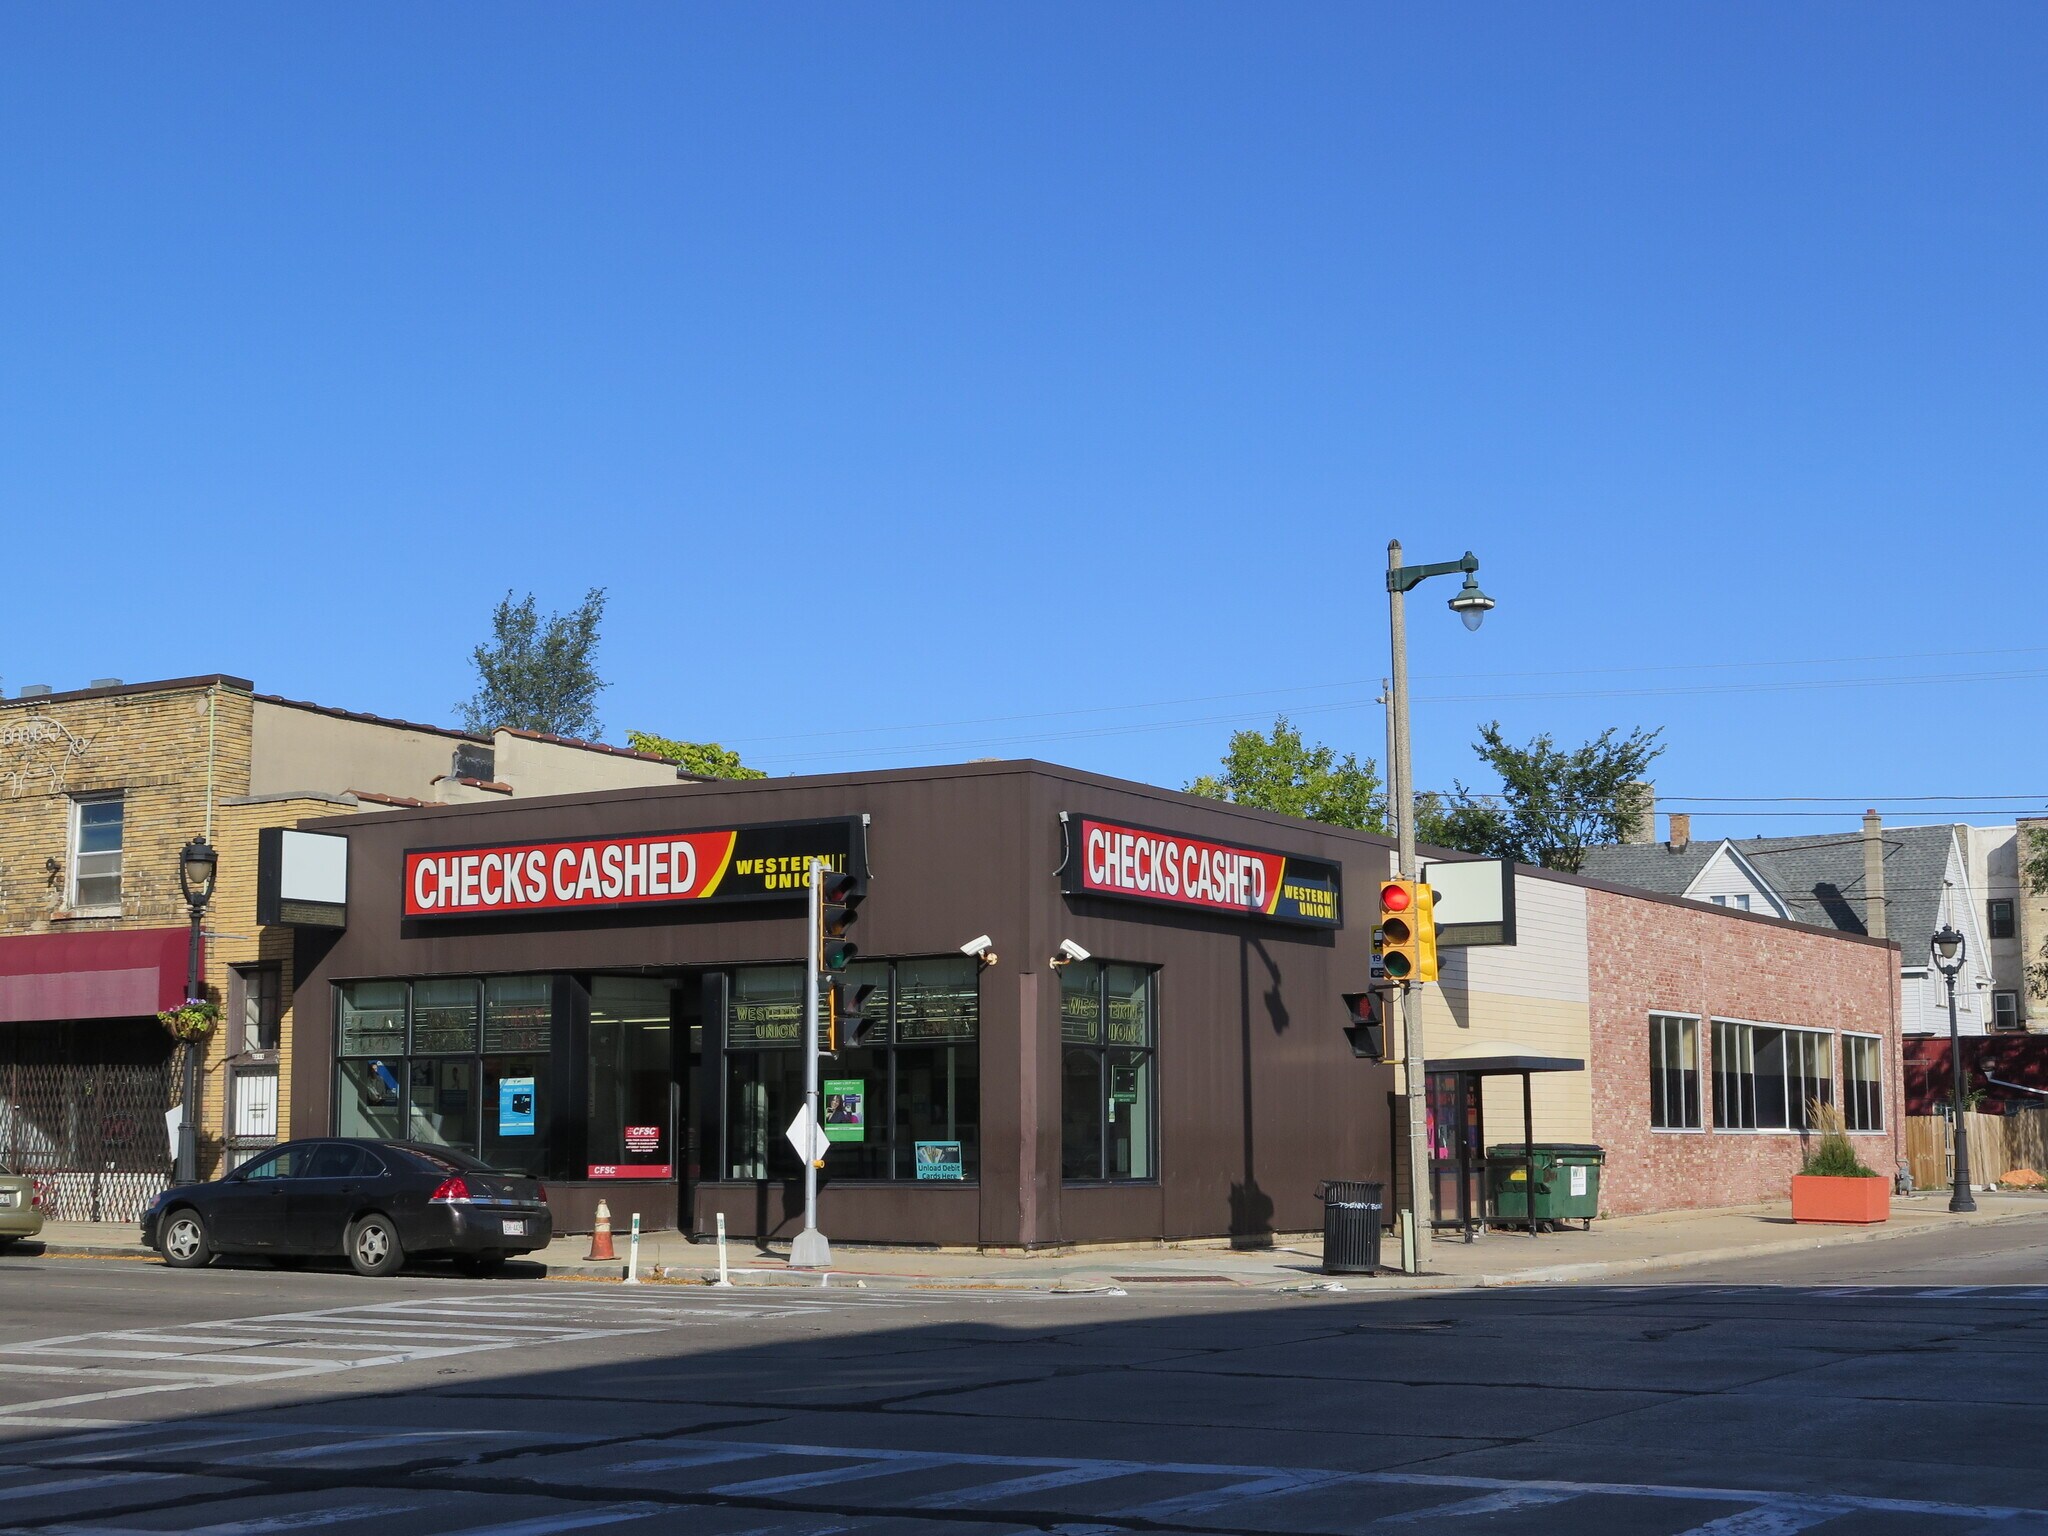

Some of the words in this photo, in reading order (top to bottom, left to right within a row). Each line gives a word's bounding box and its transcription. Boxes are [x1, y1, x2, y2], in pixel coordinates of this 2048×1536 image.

[414, 849, 547, 909] CHECKS
[552, 841, 696, 900] CASHED
[1088, 828, 1179, 896] CHECKS
[1183, 846, 1265, 907] CASHED
[765, 872, 811, 889] UNIO
[1284, 885, 1331, 905] WESTERN
[1299, 902, 1332, 918] UNION
[736, 1005, 798, 1021] WESTERN
[1069, 997, 1137, 1019] WESERN
[756, 1022, 798, 1039] UNION
[633, 1127, 656, 1135] CFSC
[594, 1166, 616, 1174] CFSC
